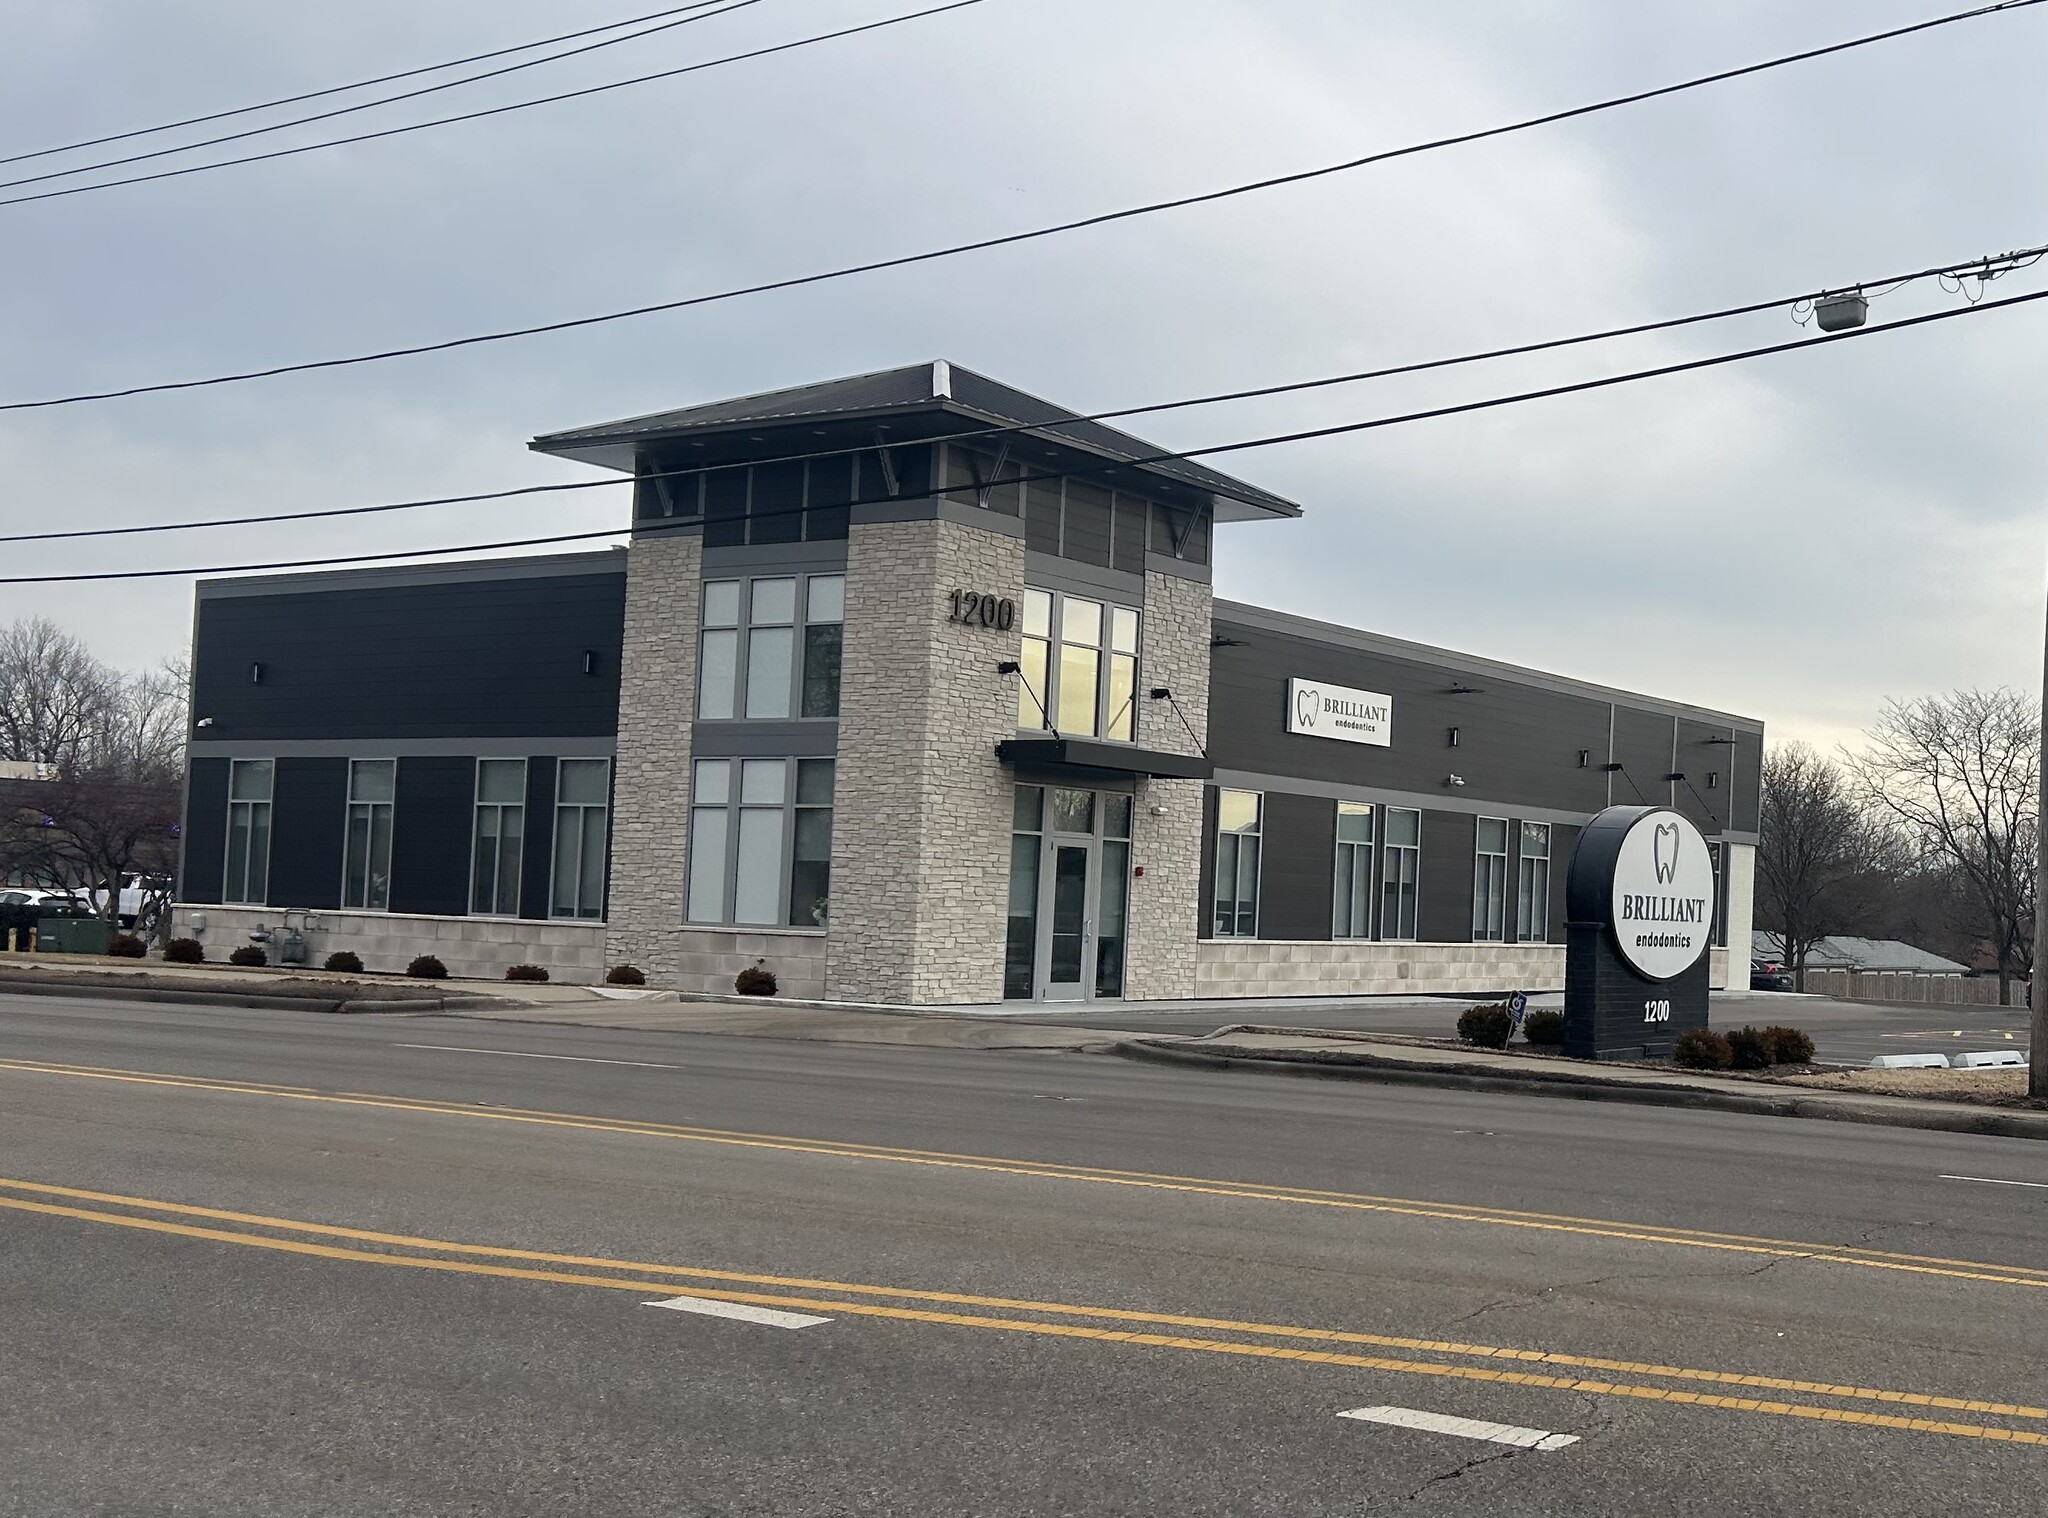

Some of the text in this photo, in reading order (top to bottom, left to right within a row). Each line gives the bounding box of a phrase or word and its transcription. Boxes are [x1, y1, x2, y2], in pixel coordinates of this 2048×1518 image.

[950, 589, 1015, 630] 1200
[1324, 698, 1387, 721] BRILLIANT
[1335, 719, 1376, 732] endodontics
[1622, 895, 1705, 922] BRILLIANT
[1636, 931, 1691, 948] endodontics
[1644, 1000, 1670, 1022] 1200
